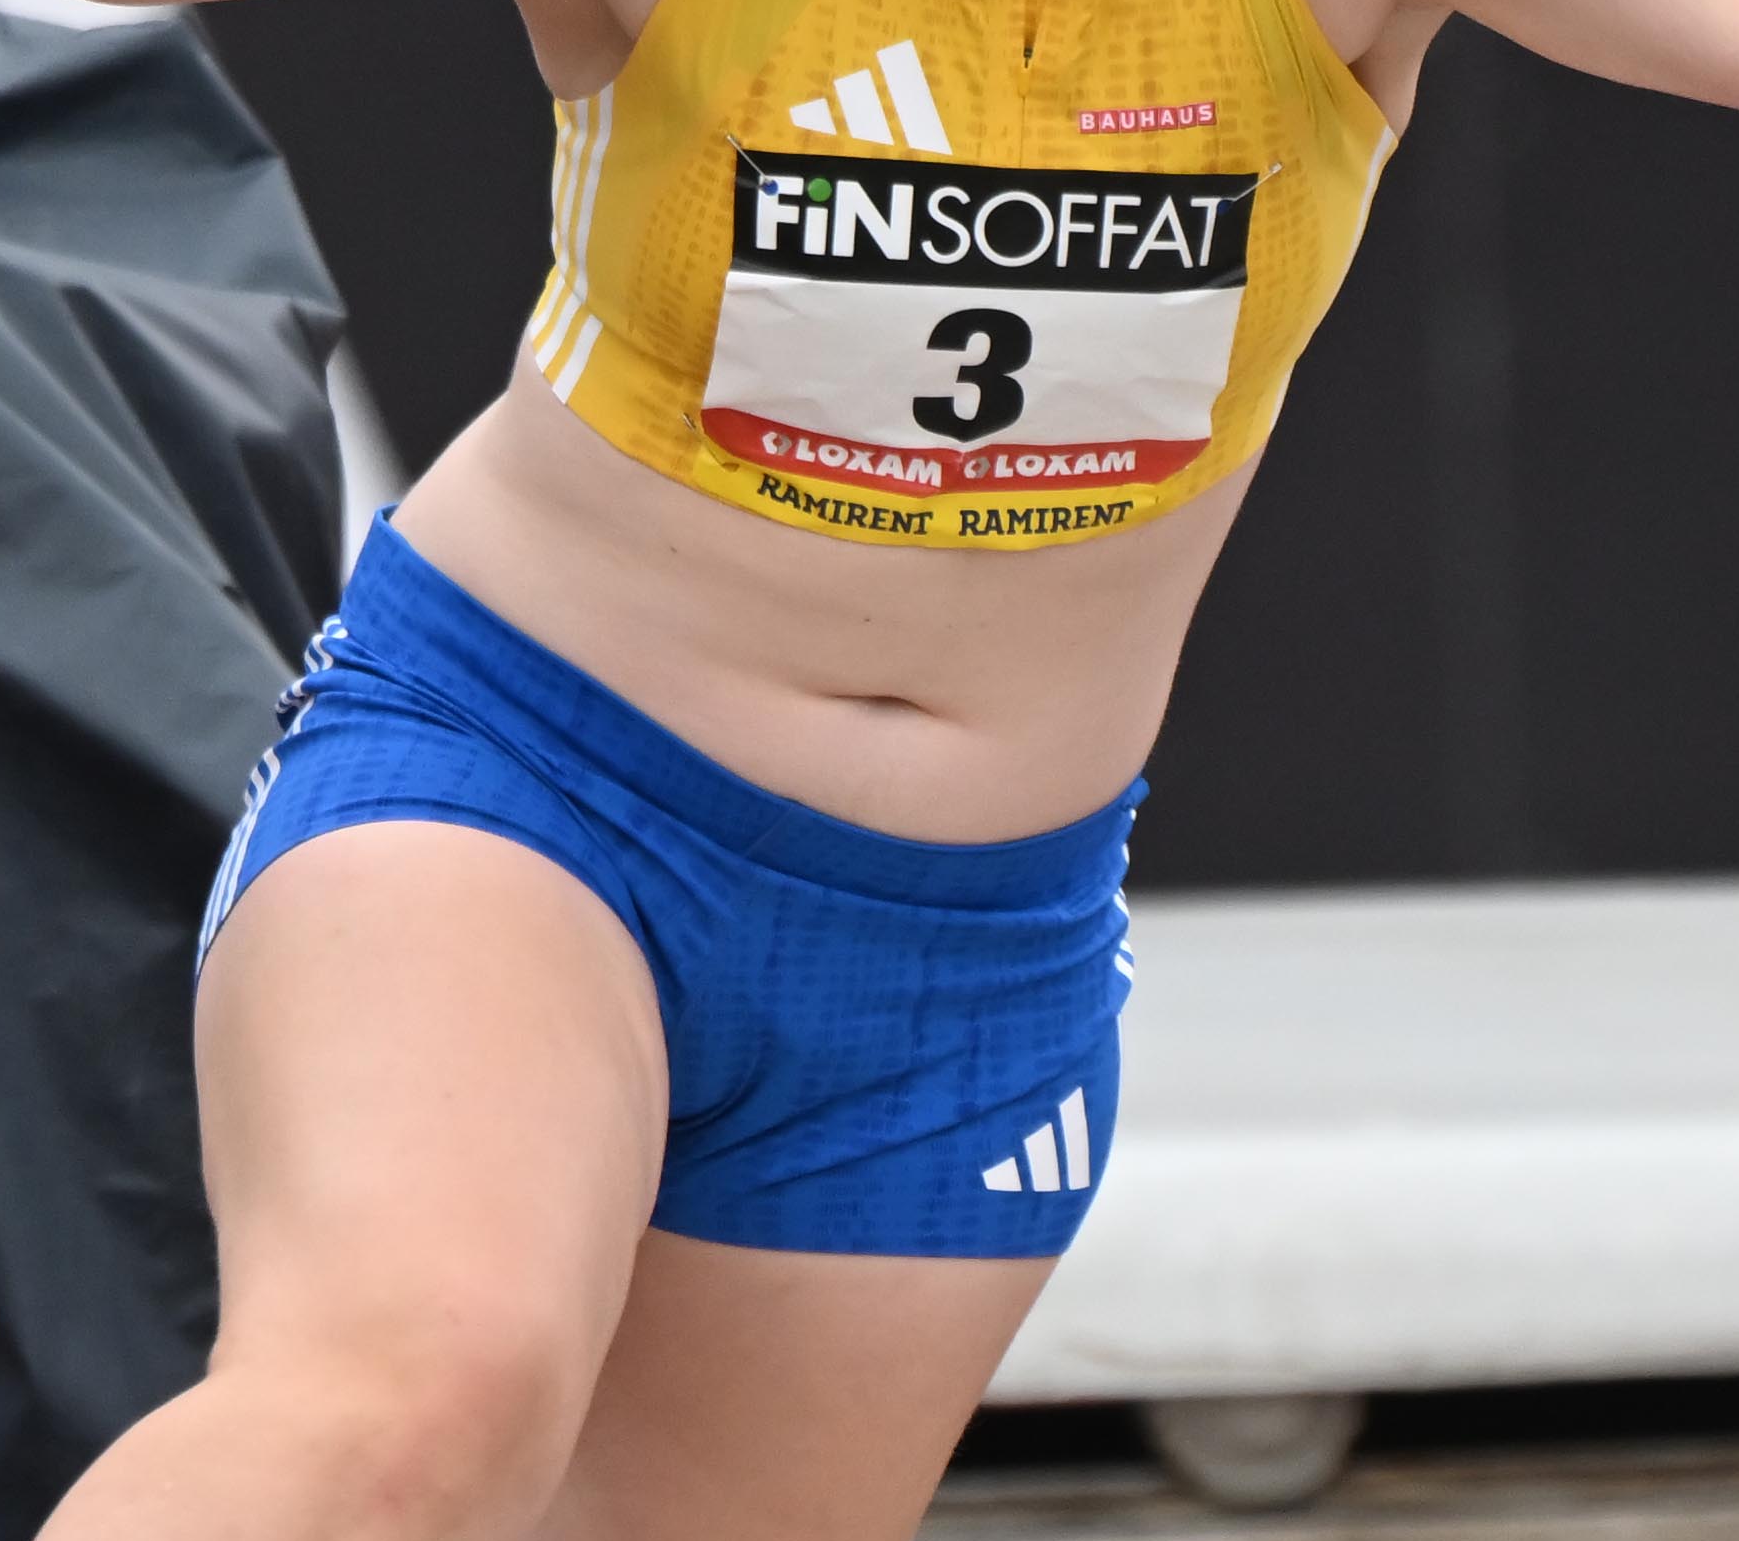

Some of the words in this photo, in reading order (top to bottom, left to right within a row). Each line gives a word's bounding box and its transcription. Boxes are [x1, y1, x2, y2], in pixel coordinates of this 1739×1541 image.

[1081, 104, 1213, 130] BAUHAUS
[912, 307, 1033, 443] 3
[795, 438, 942, 487] LOXAM
[994, 449, 1137, 478] LOXAM
[757, 473, 933, 535] RAMIRENT
[958, 501, 1133, 537] RAMIRENT
